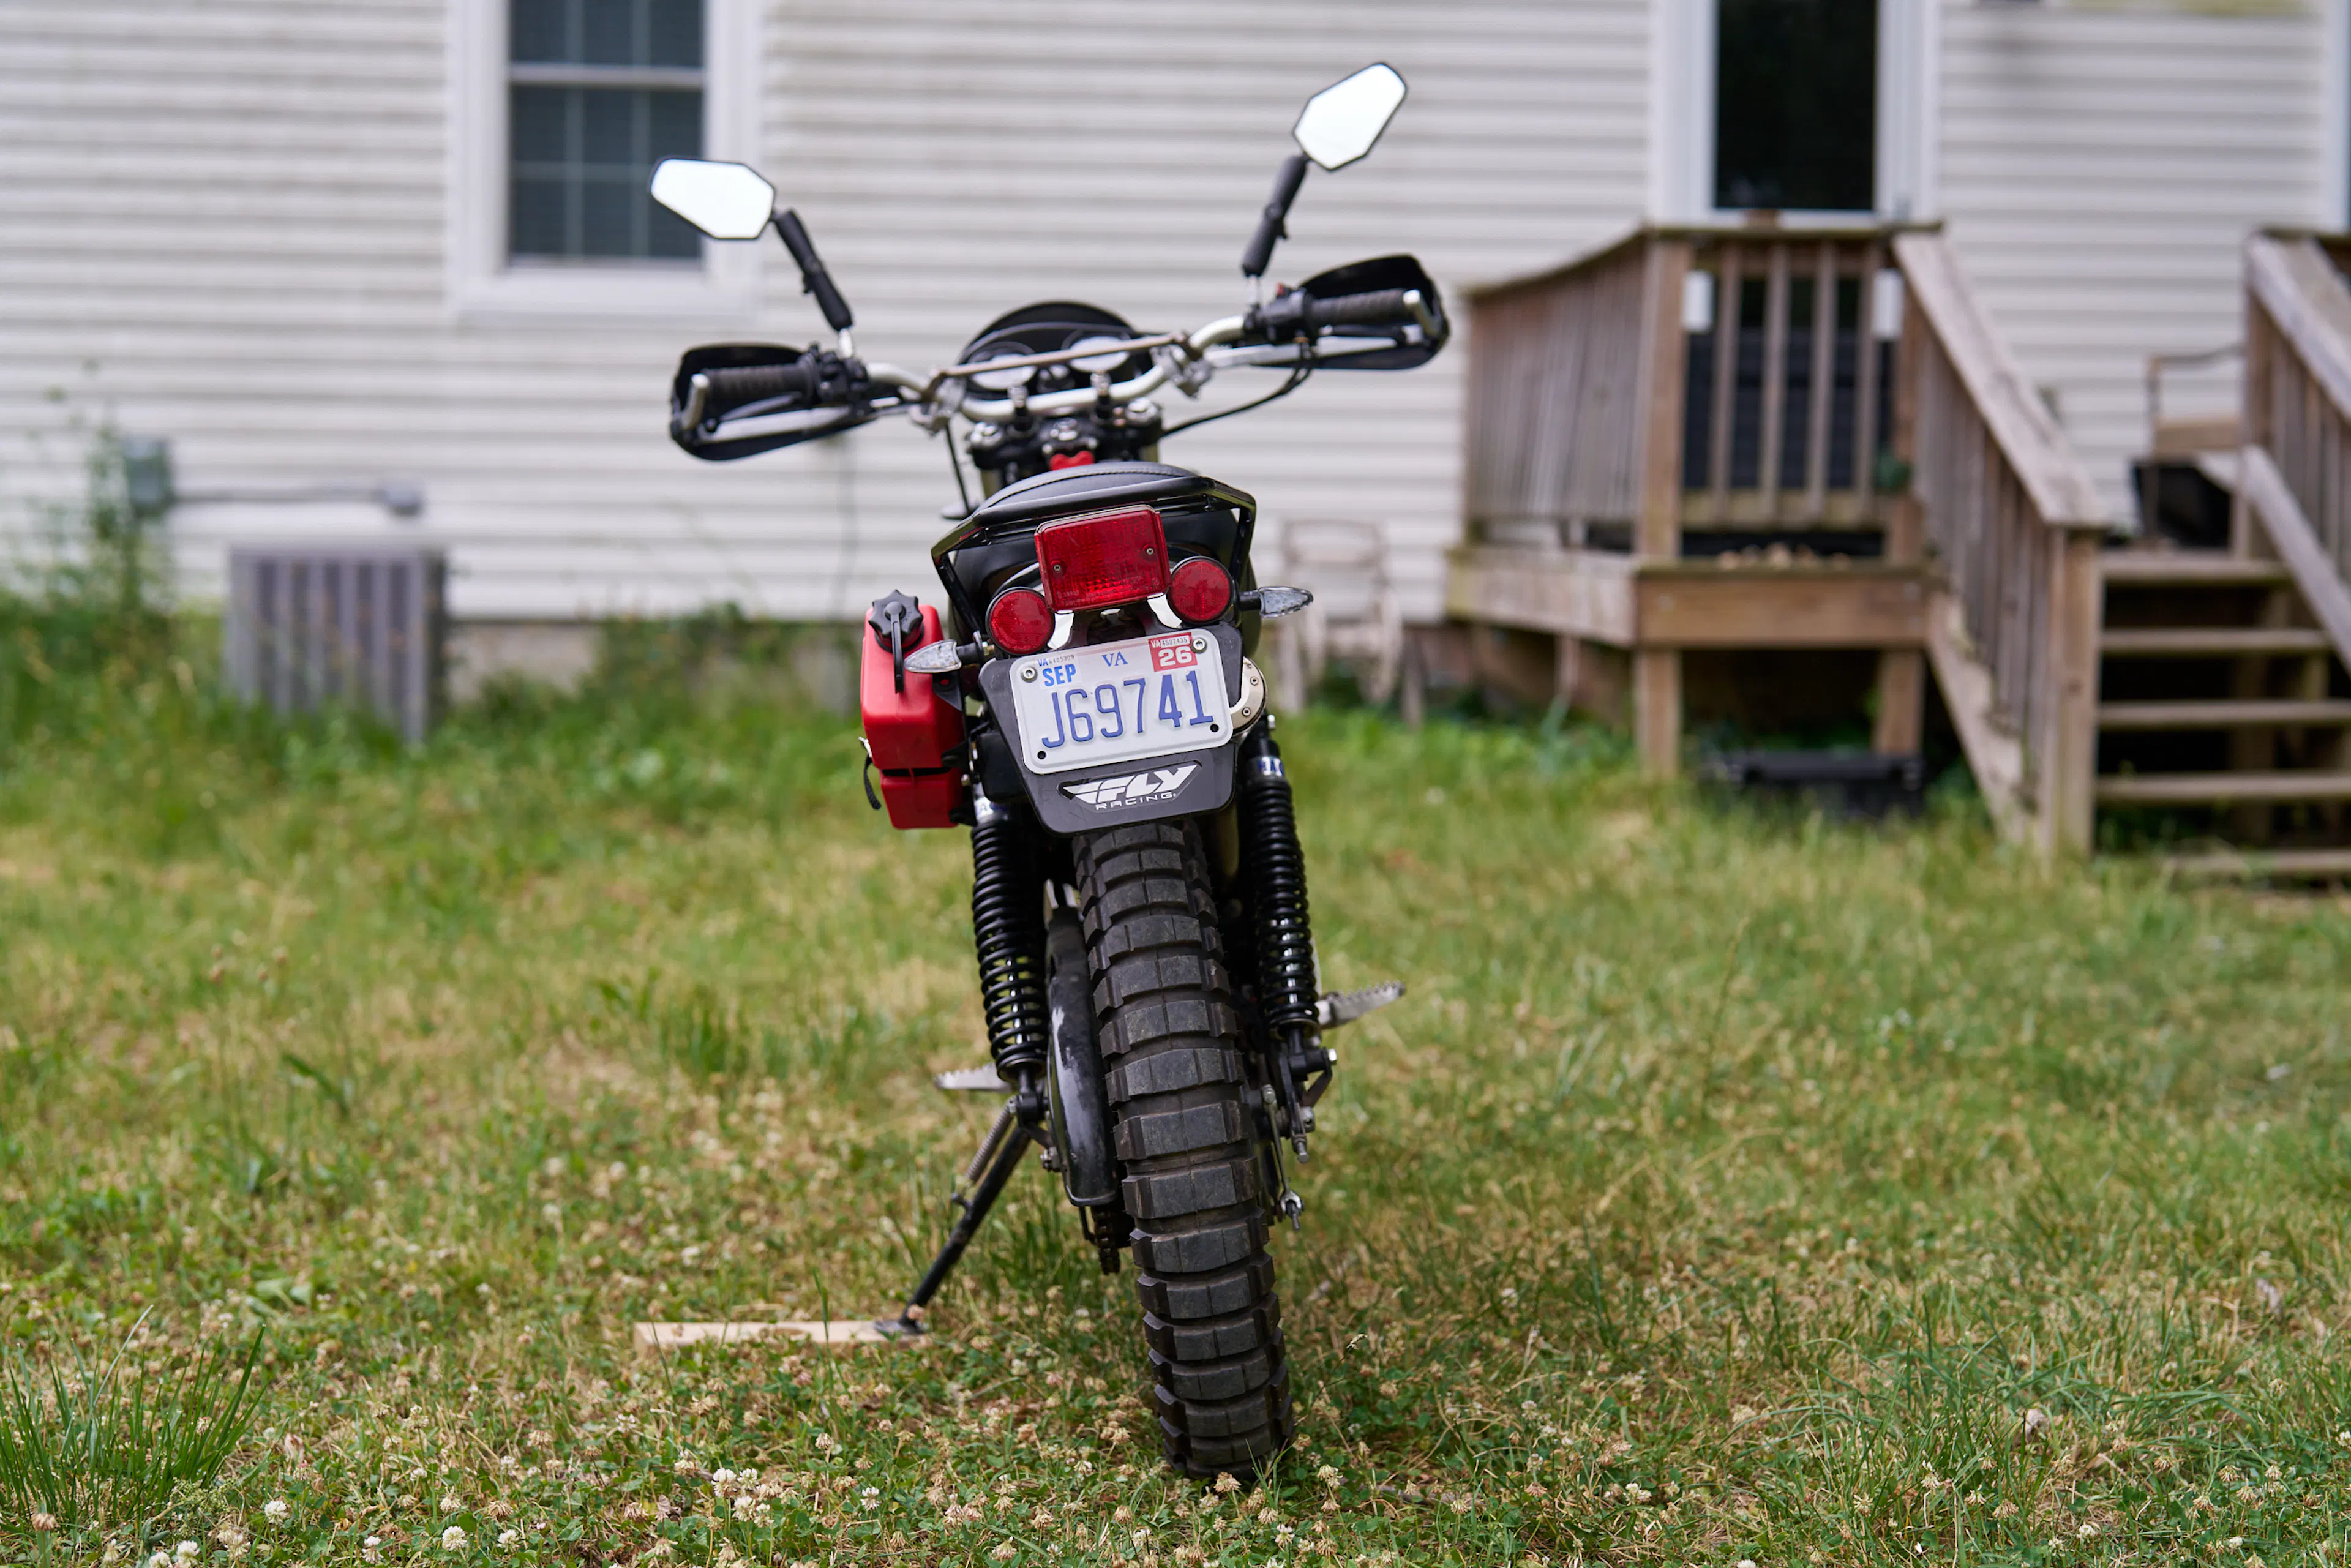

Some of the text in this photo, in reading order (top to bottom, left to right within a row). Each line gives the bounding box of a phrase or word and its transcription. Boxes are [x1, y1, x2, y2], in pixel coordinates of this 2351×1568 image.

[1151, 639, 1161, 648] VA
[1037, 658, 1048, 667] VA
[1102, 651, 1128, 667] VA
[1158, 646, 1192, 667] 26
[1043, 664, 1076, 686] SEP
[1041, 670, 1213, 748] J69741
[1062, 764, 1198, 804] FLY
[1095, 792, 1172, 811] RACING
